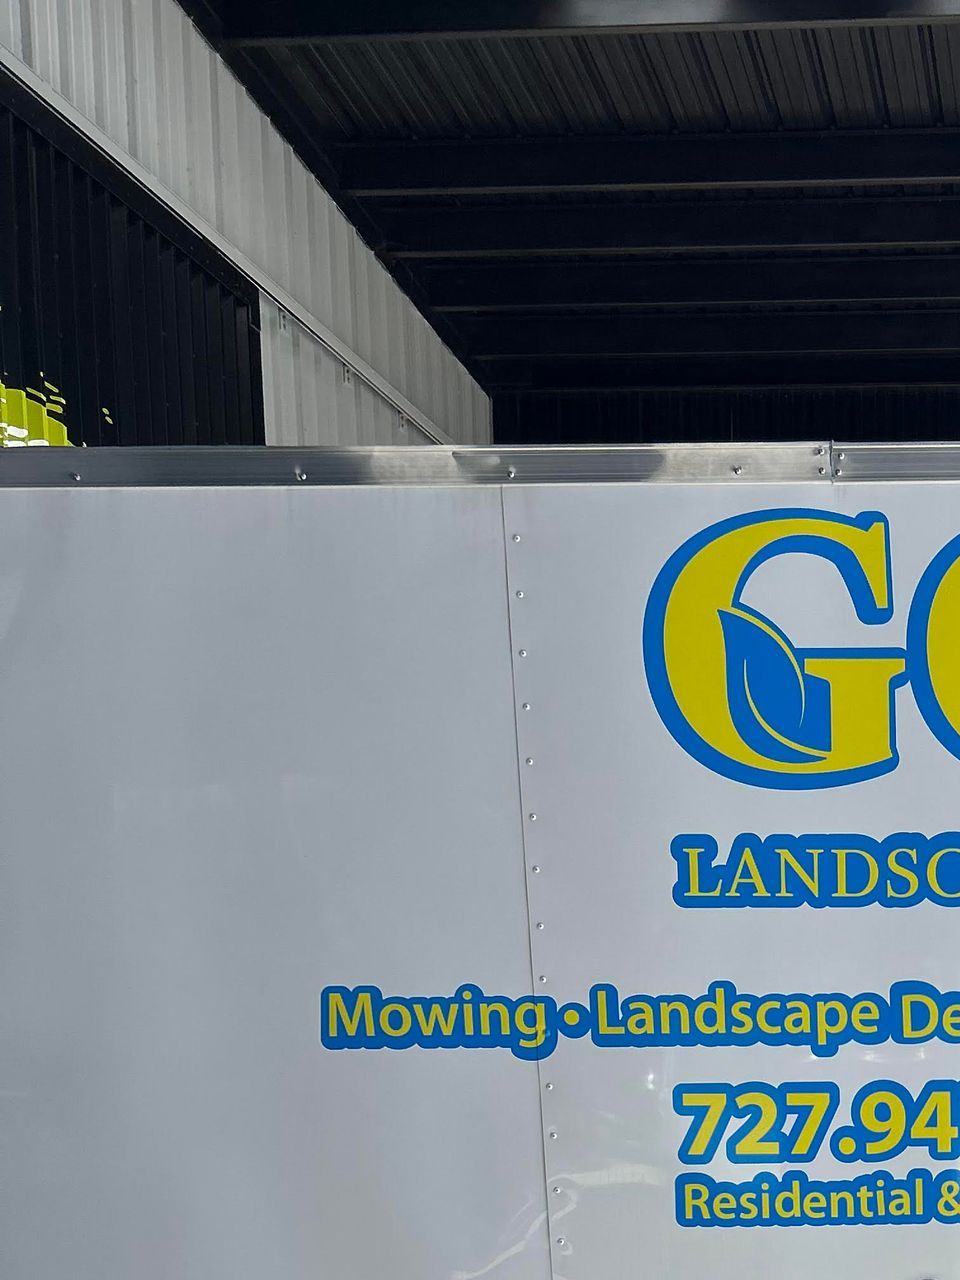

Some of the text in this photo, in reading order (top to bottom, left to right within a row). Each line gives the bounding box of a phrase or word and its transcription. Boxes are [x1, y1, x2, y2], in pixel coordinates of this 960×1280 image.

[327, 990, 547, 1049] Mowing
[596, 987, 880, 1046] Landscape
[683, 1178, 924, 1220] Residential
